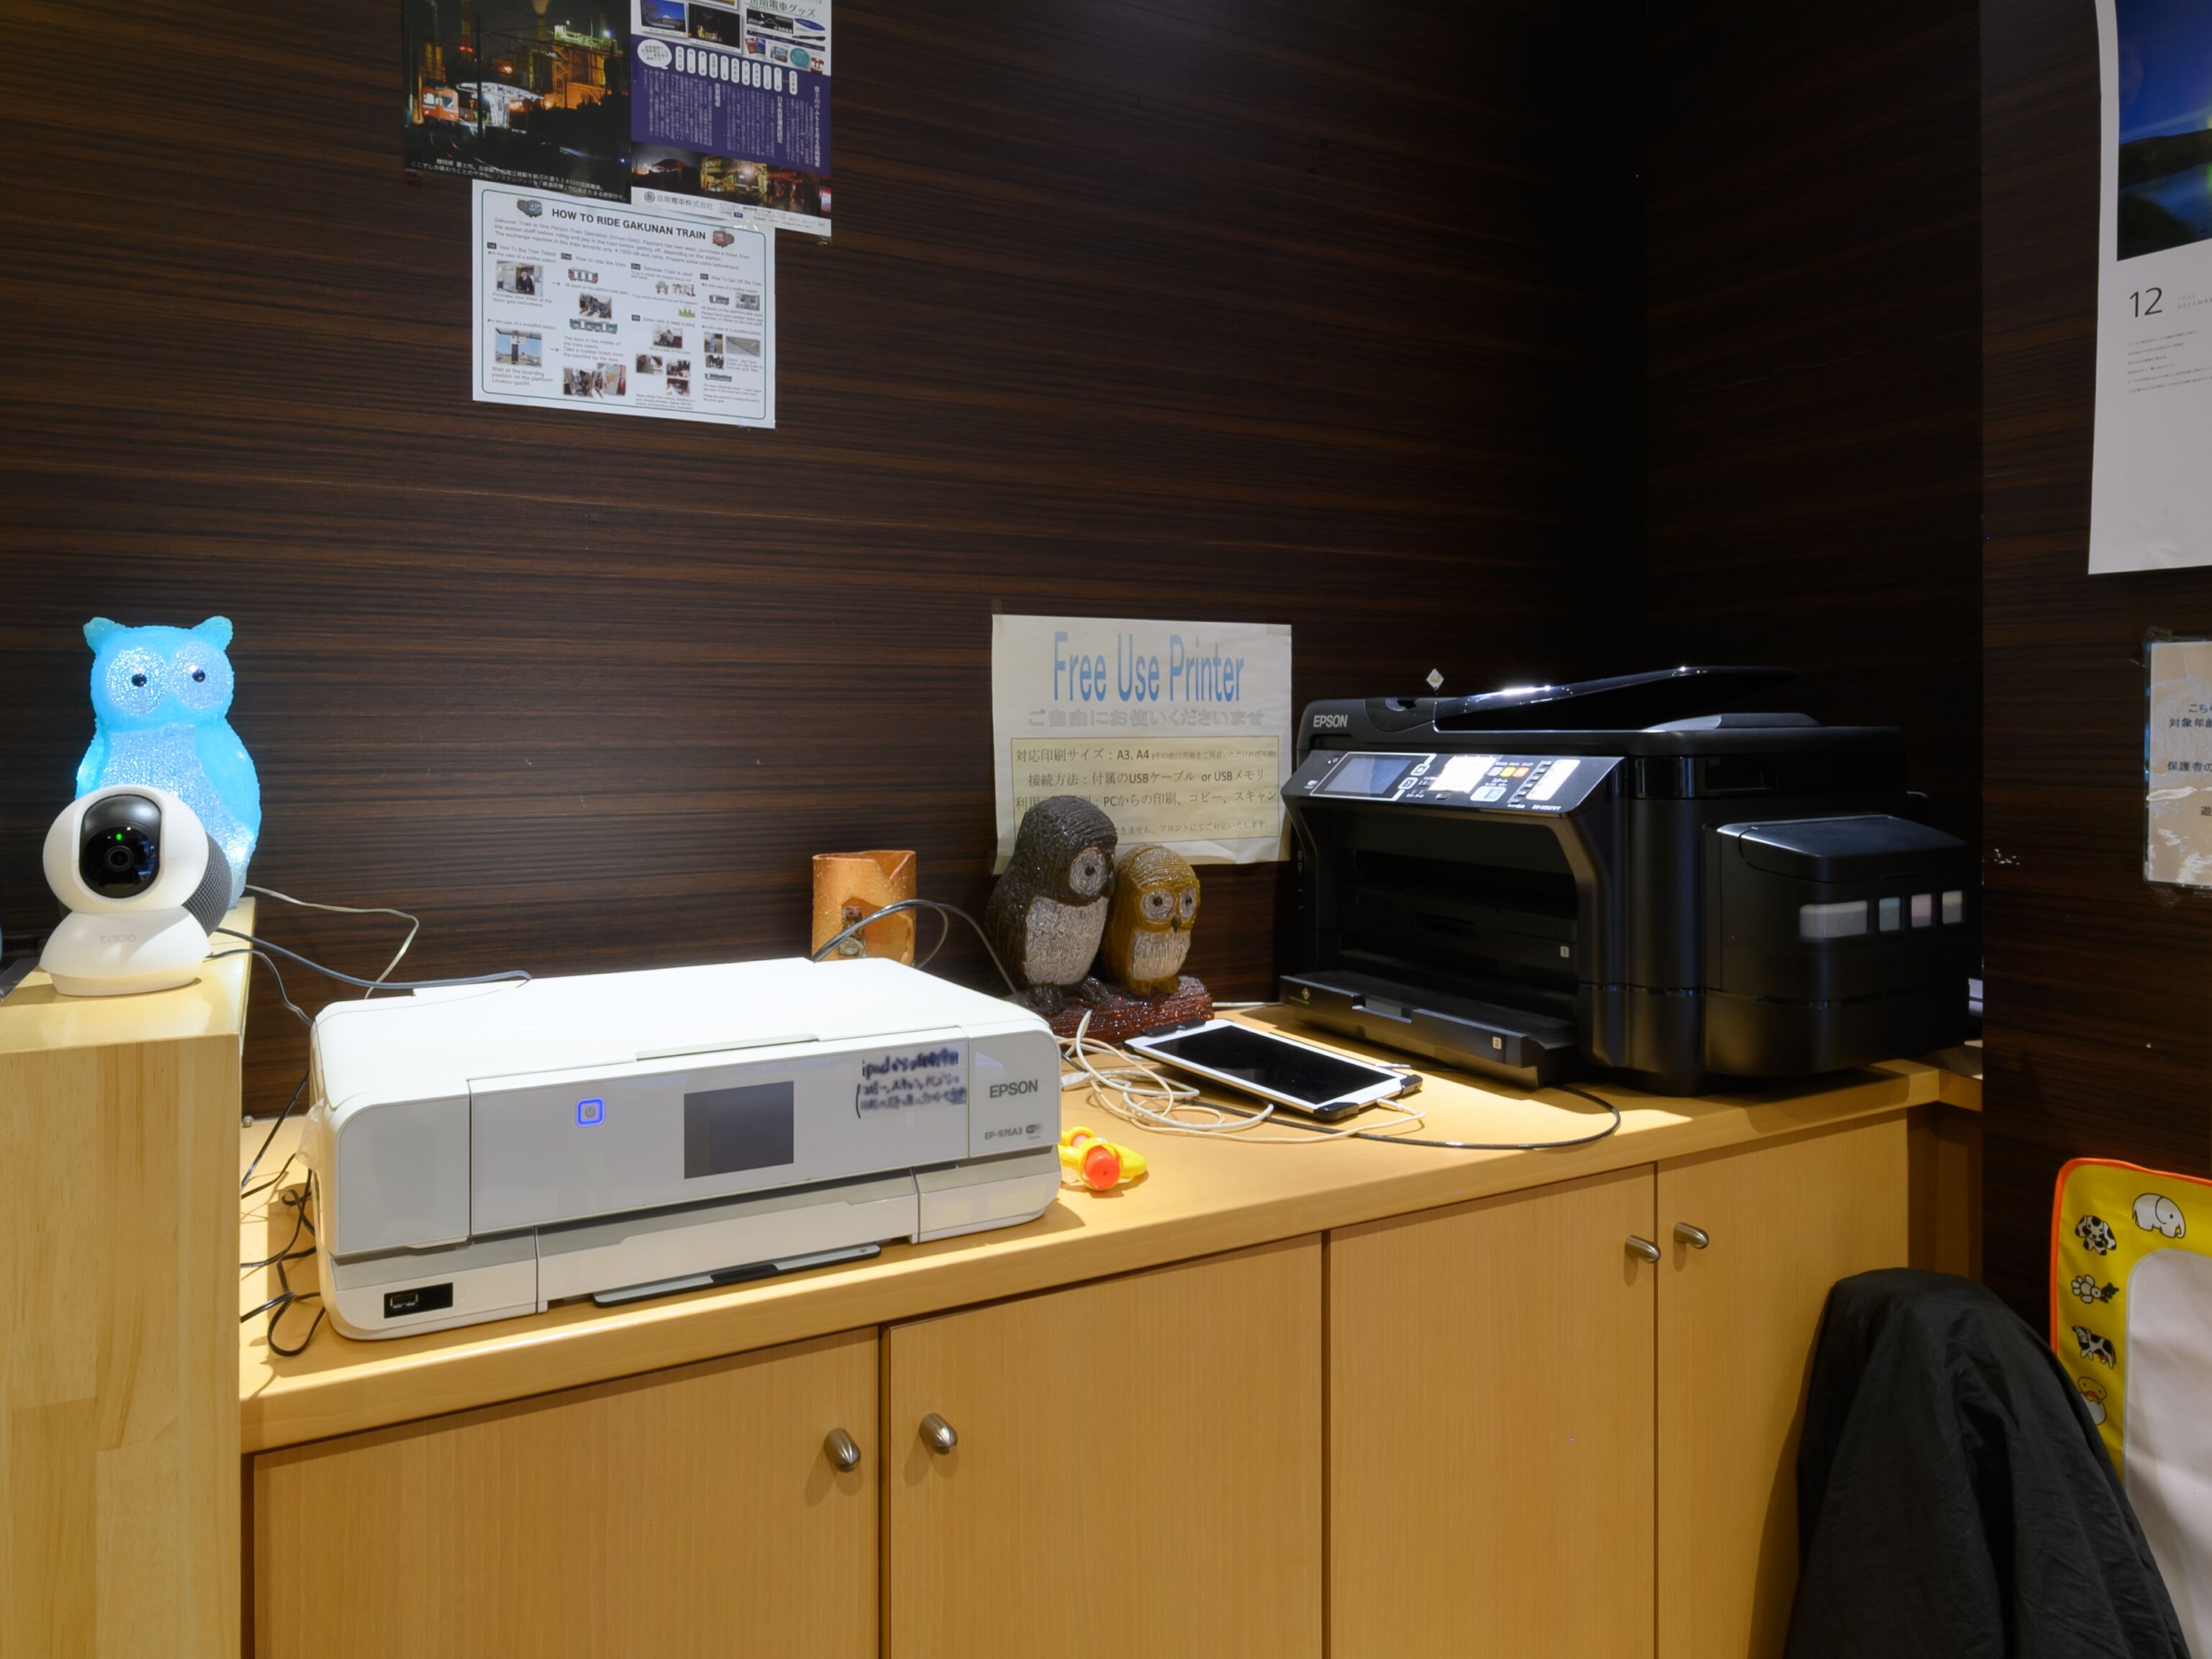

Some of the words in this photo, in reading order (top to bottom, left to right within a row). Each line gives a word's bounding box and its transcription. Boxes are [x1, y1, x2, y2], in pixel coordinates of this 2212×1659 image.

[656, 194, 713, 209] 岳南電車株式会社
[552, 208, 576, 220] HOW
[579, 212, 594, 222] TO
[597, 215, 620, 227] RIDE
[622, 220, 673, 235] GAKUNAN
[676, 227, 705, 240] TRAIN
[2129, 287, 2163, 318] 12
[1053, 630, 1107, 702] Free
[1118, 633, 1159, 702] Use
[1169, 634, 1244, 702] Printer
[1028, 708, 1265, 728] ご自由にお使いくださいませ
[1313, 715, 1348, 728] EPSON
[1214, 769, 1264, 782] USBメモリ
[989, 1079, 1038, 1098] EPSON
[985, 1127, 1023, 1140] EP-976A3
